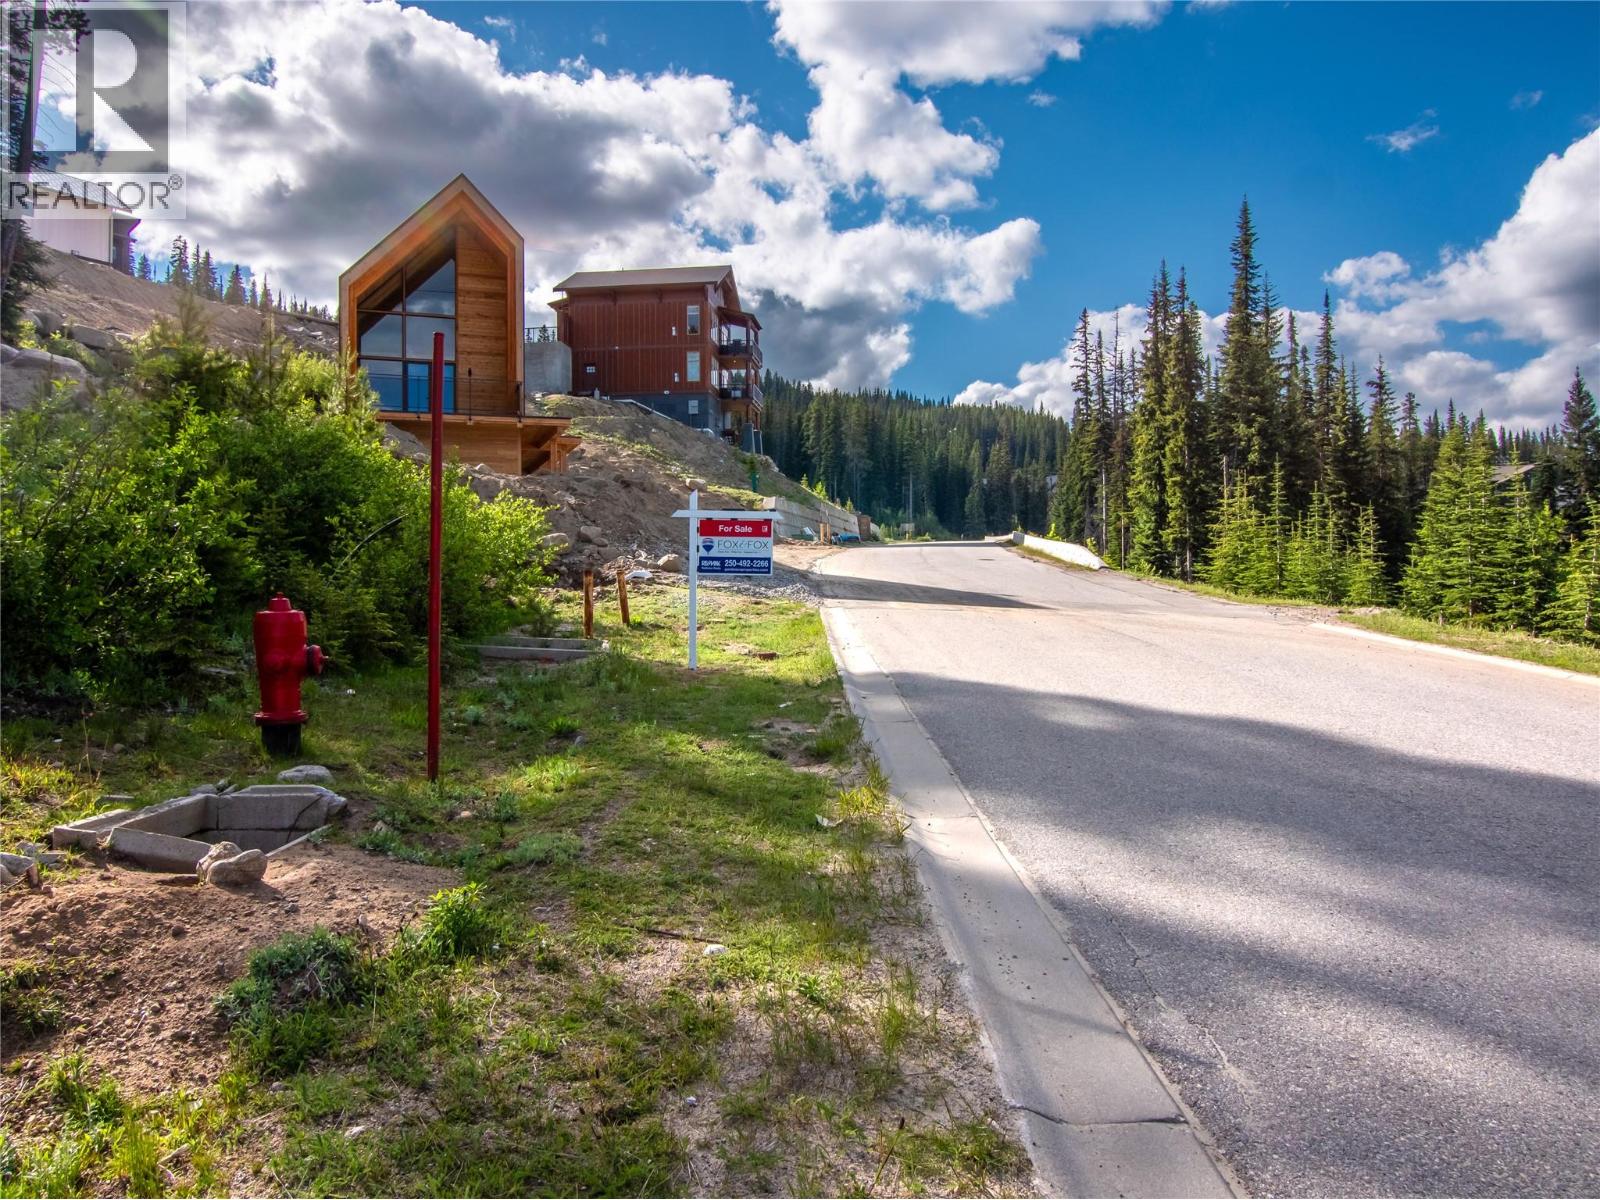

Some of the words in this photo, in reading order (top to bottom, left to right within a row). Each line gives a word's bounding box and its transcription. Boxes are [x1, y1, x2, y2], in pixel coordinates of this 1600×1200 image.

[718, 525, 733, 533] For
[734, 525, 753, 533] Sale
[724, 559, 769, 567] 250-492-2266
